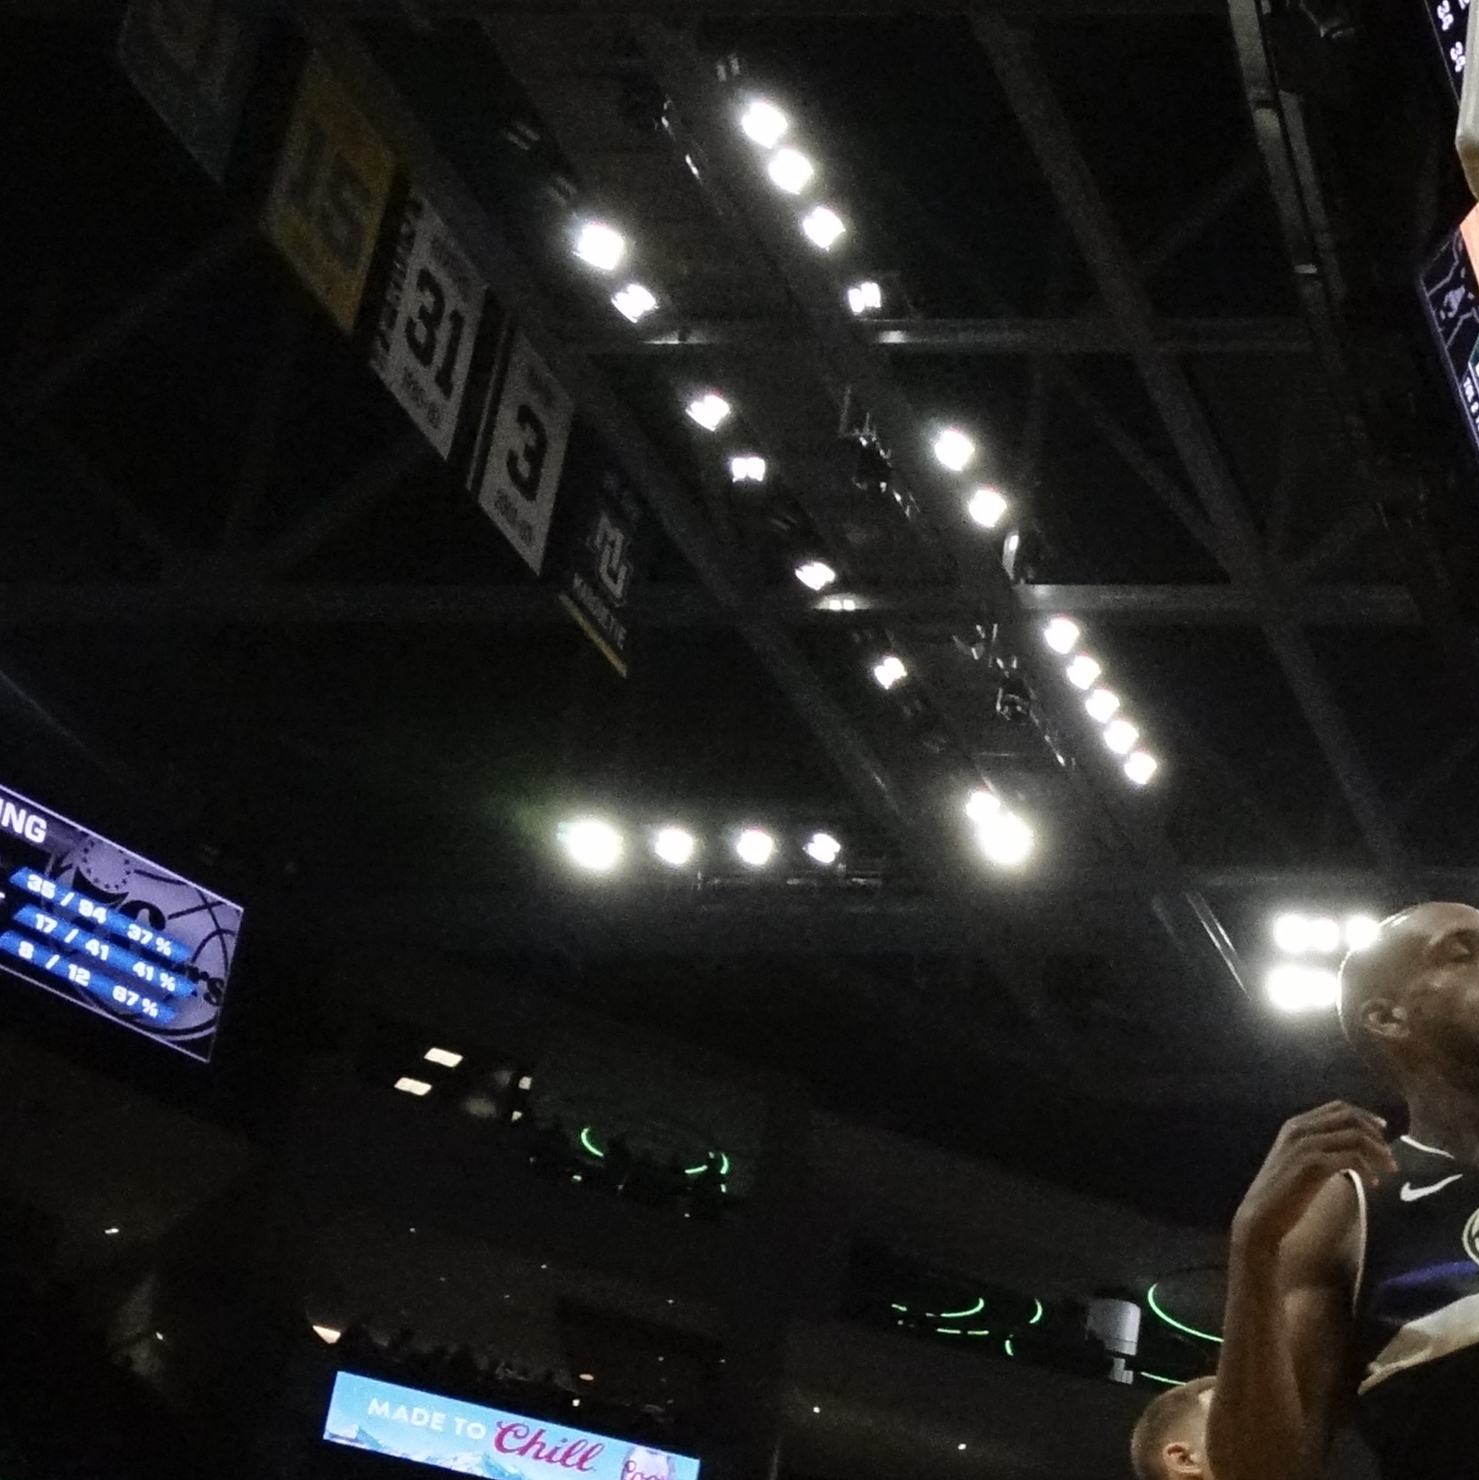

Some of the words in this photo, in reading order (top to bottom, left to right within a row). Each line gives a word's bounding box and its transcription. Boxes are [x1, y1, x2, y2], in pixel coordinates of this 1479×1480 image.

[405, 268, 465, 400] 31
[506, 404, 547, 502] 3
[26, 874, 56, 900] 35
[35, 913, 58, 933] 17
[85, 938, 110, 961] 41
[67, 963, 91, 987] 12
[367, 1396, 447, 1433] MADE
[454, 1417, 488, 1440] TO
[494, 1419, 606, 1474] Chill
